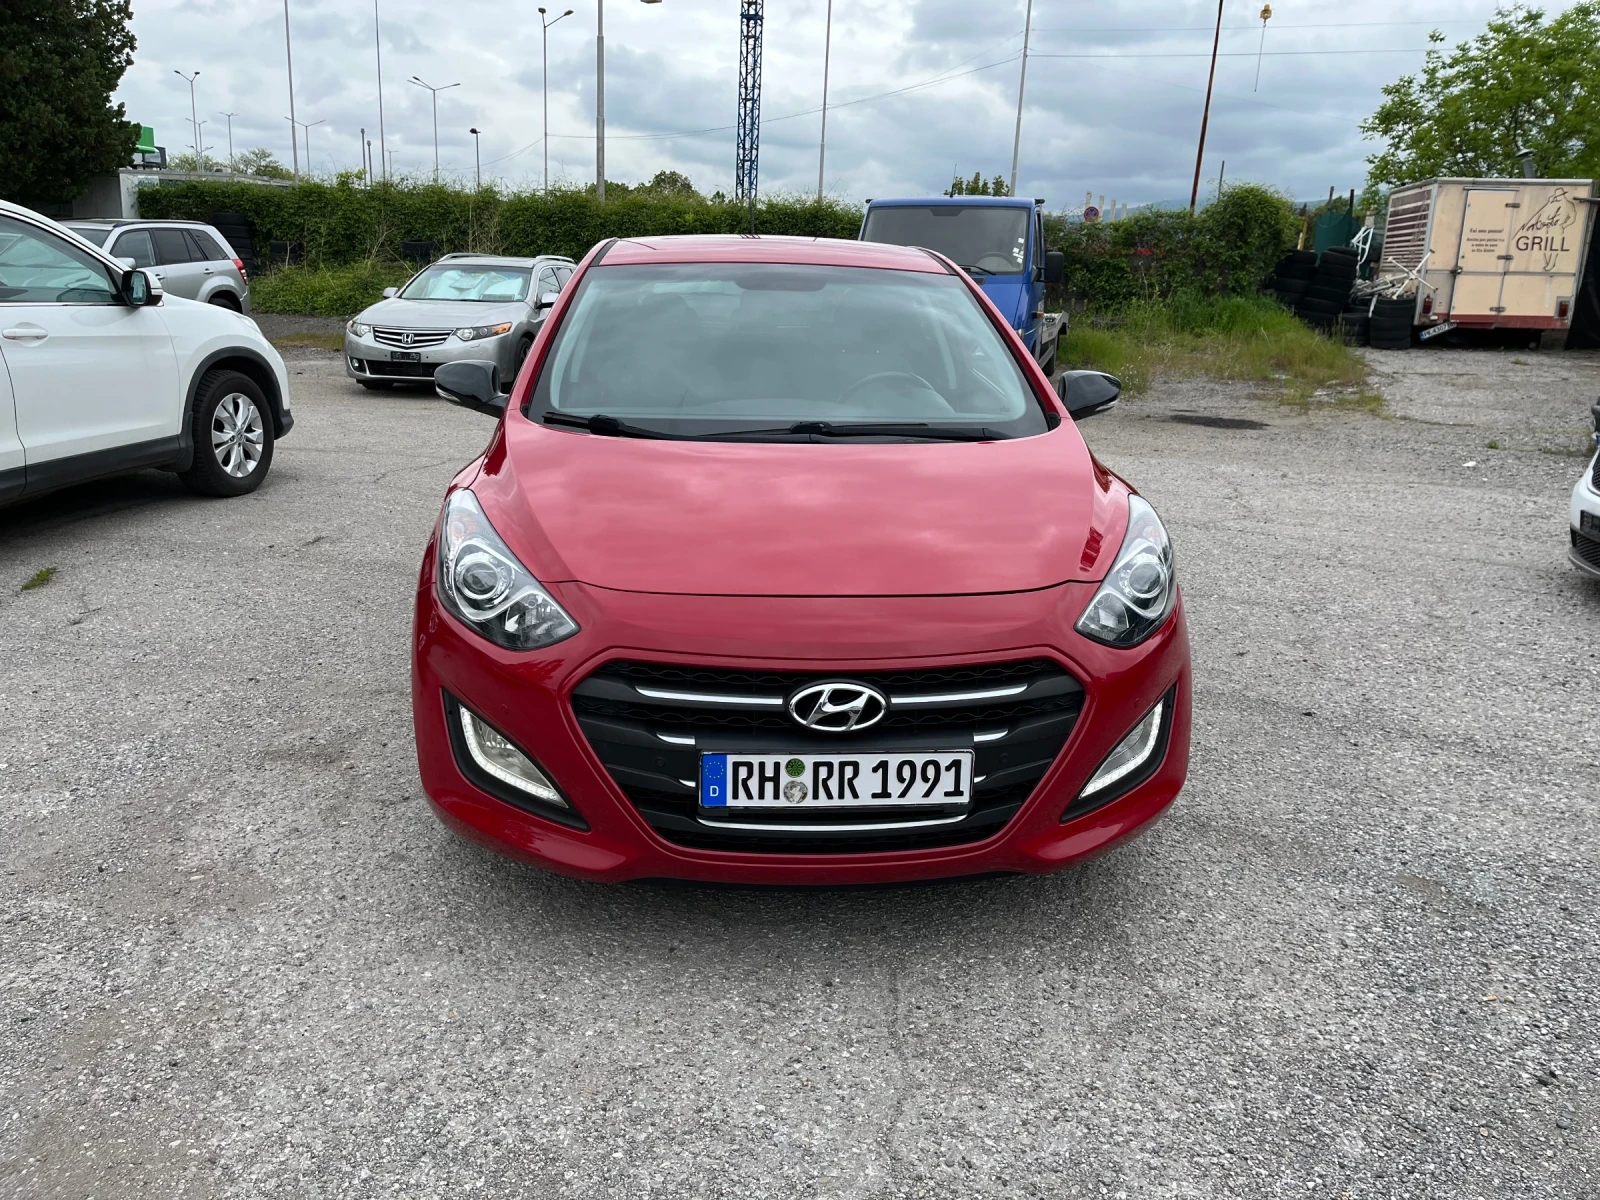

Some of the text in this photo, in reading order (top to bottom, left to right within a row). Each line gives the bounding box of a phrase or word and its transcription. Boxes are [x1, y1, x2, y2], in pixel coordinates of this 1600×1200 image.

[1516, 235, 1571, 252] GRILL
[732, 758, 965, 800] RH RR 1991
[709, 785, 720, 797] D
